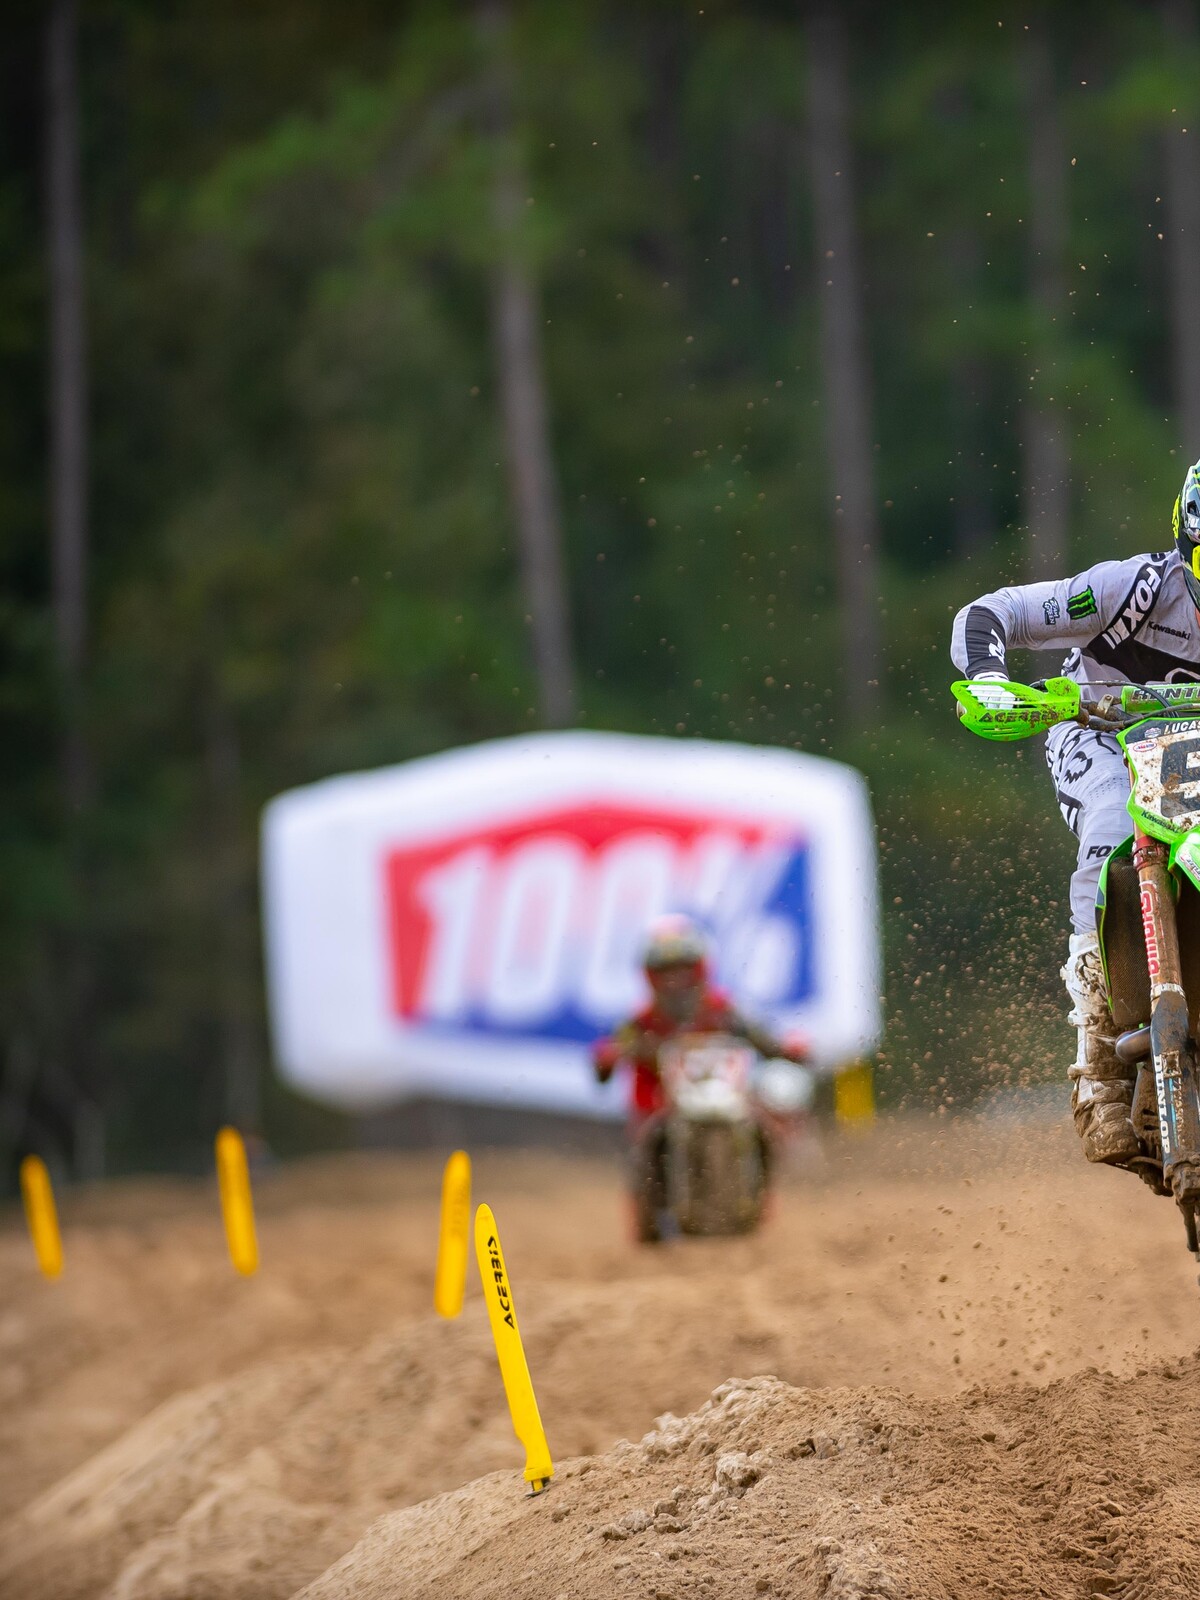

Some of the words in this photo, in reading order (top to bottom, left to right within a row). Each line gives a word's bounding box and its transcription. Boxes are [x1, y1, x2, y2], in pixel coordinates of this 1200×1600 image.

[1122, 566, 1162, 633] FOX
[1149, 621, 1191, 641] Kawasaki
[1086, 845, 1118, 860] FO
[1153, 1053, 1171, 1154] DUNLOP
[487, 1235, 516, 1330] ACERBIS
